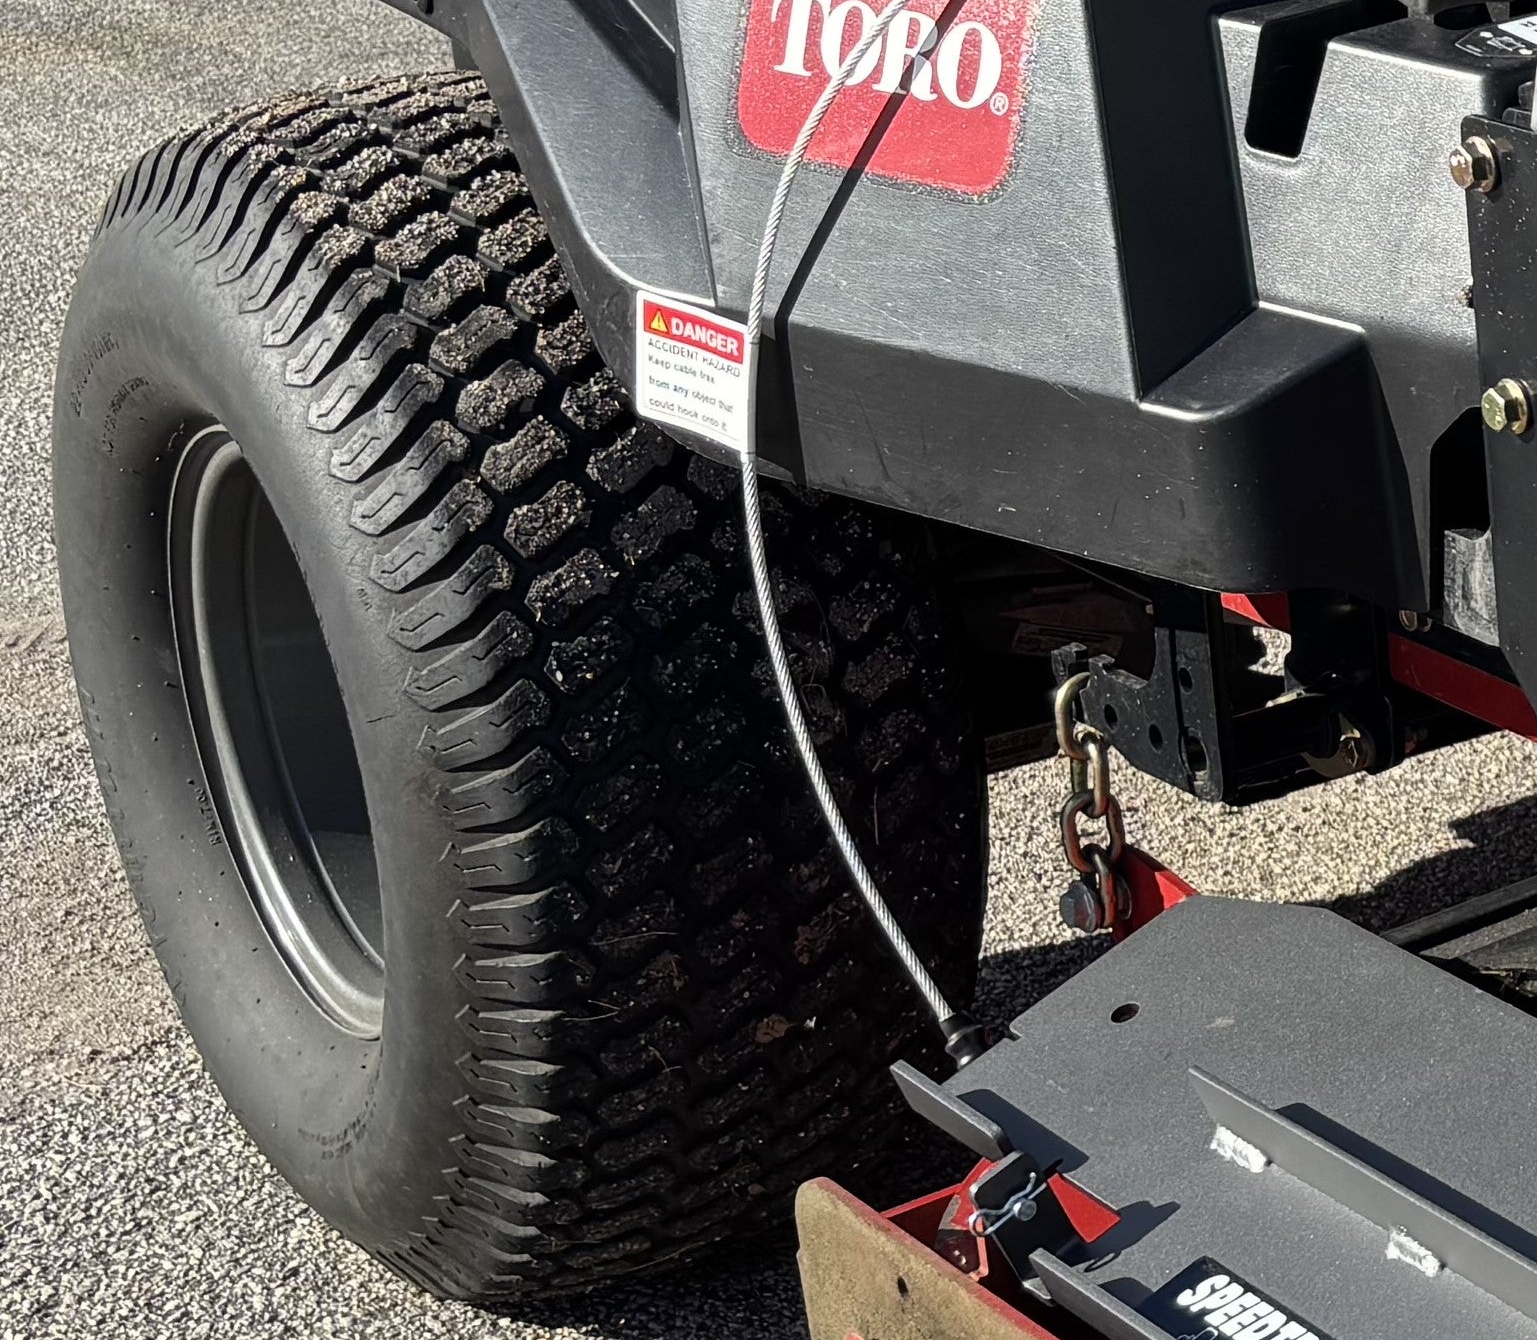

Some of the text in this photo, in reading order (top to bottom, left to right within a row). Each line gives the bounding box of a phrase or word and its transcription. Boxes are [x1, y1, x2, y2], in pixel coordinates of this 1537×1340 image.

[671, 316, 739, 357] DANGER
[648, 338, 741, 378] ACCIDENT HAZARD
